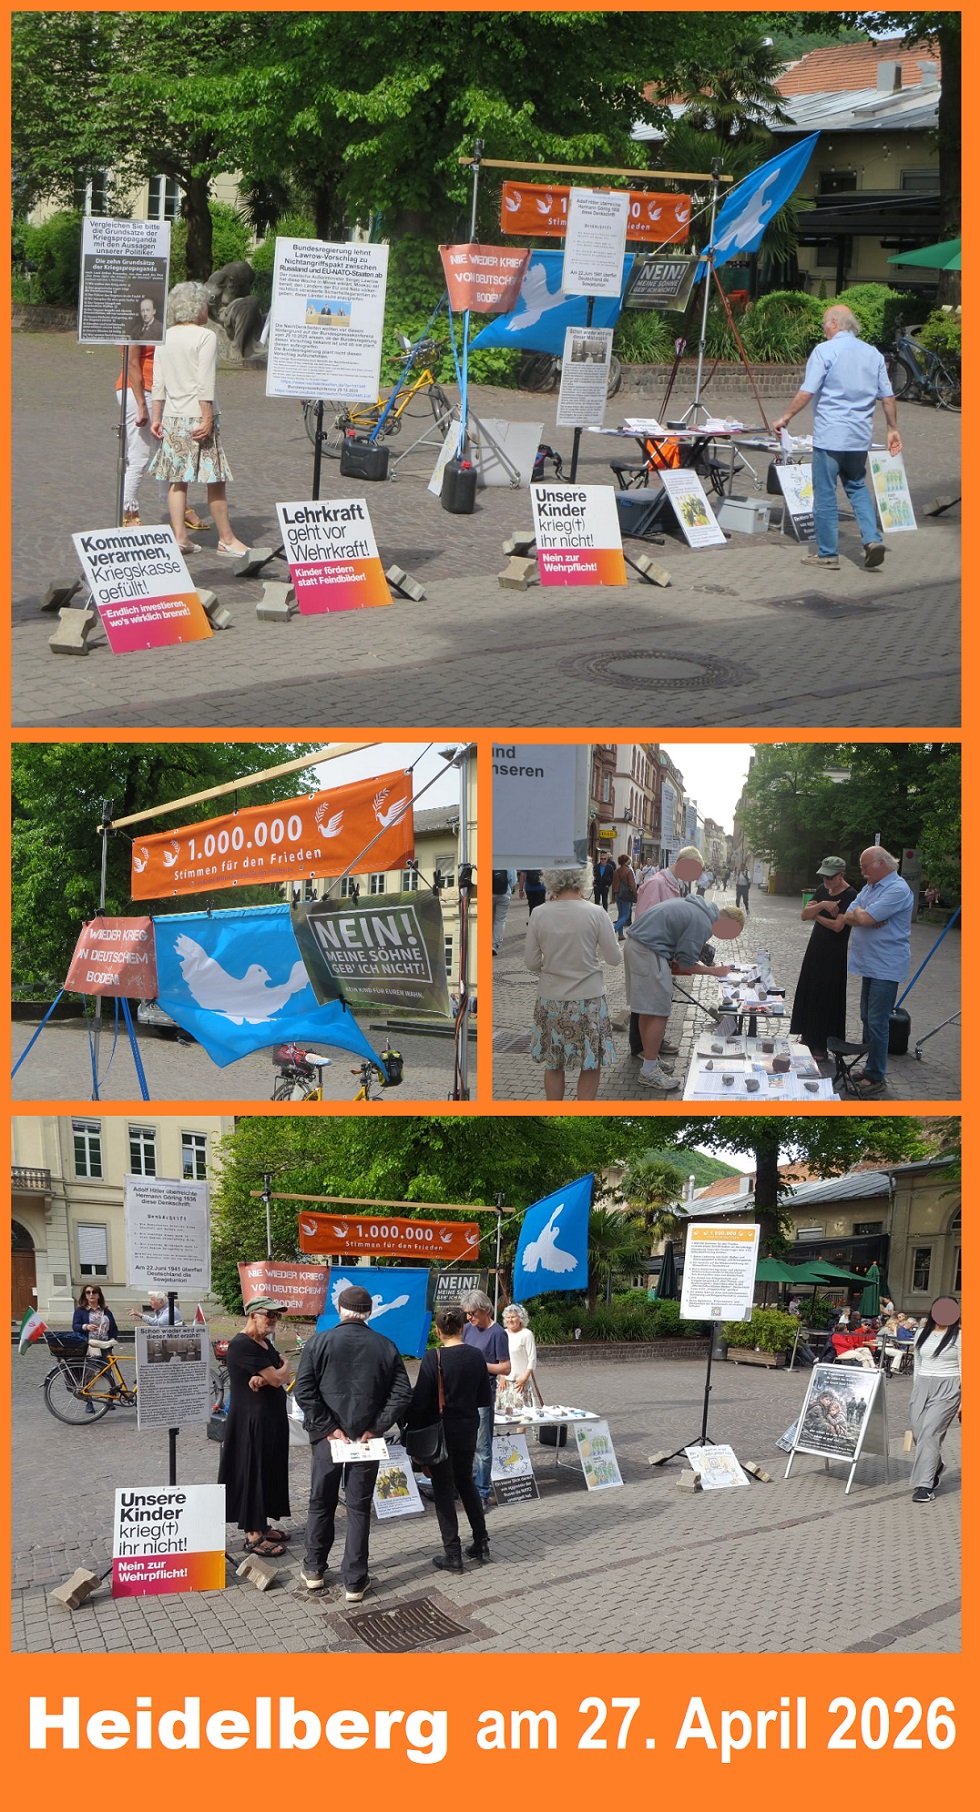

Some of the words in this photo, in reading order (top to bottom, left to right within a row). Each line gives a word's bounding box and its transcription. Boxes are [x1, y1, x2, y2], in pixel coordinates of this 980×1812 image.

[90, 221, 130, 229] Vergleichen
[93, 234, 156, 243] Kriegspropaganda
[293, 244, 352, 255] Bundesregierung
[285, 258, 344, 269] Nichtangriffspakt
[295, 252, 357, 263] Lawrow-Vorschlag
[450, 254, 468, 264] NIE
[322, 268, 374, 278] EU-NATO-Staaten
[640, 265, 687, 280] NEIN!
[536, 489, 586, 502] Unsere
[282, 504, 365, 524] Lehrkraft
[537, 503, 586, 516] Kinder
[288, 524, 321, 545] geht
[322, 525, 346, 540] vor
[541, 534, 558, 547] ihr
[560, 534, 594, 547] nicht!
[80, 532, 173, 552] Kommunen
[87, 547, 171, 566] verarmen,
[290, 540, 370, 562] Wehrkraft!
[543, 554, 563, 562] Nein
[91, 561, 181, 583] Kriegskasse
[295, 568, 322, 577] Kinder
[324, 565, 354, 574] fördern
[544, 562, 597, 573] Wehrpflicht!
[298, 577, 318, 586] statt
[320, 573, 366, 584] Feindbilder!
[98, 580, 150, 603] gefüllt!
[140, 600, 186, 612] investieren,
[110, 617, 129, 627] wo's
[130, 612, 162, 624] wirklich
[162, 608, 190, 619] brennt!
[188, 815, 302, 861] 1.000.000
[174, 866, 217, 881] Stimmen
[221, 860, 238, 872] für
[243, 857, 264, 868] den
[270, 849, 322, 864] Frieden
[90, 929, 121, 940] WIEDER
[122, 930, 147, 941] KRIEG
[314, 913, 417, 948] NEIN!
[91, 950, 148, 964] DEUTSCHEM
[325, 951, 368, 962] MEINE
[369, 947, 422, 961] SÖHNE
[331, 964, 355, 973] GEB'
[360, 964, 380, 974] ICH
[382, 963, 425, 975] NICHT!
[356, 1224, 434, 1241] 1.000.000
[345, 1240, 380, 1248] Stimmen
[248, 1269, 263, 1278] NIE
[265, 1269, 297, 1279] WIEDER
[299, 1272, 324, 1281] KRIEG
[251, 1284, 271, 1292] VON
[439, 1277, 477, 1289] NEIN!
[121, 1493, 186, 1507] Unsere
[121, 1507, 183, 1522] Kinder
[119, 1541, 140, 1555] ihr
[144, 1537, 187, 1554] nicht!
[118, 1562, 144, 1571] Nein
[148, 1561, 166, 1569] zur
[118, 1568, 188, 1582] Wehrpflicht!
